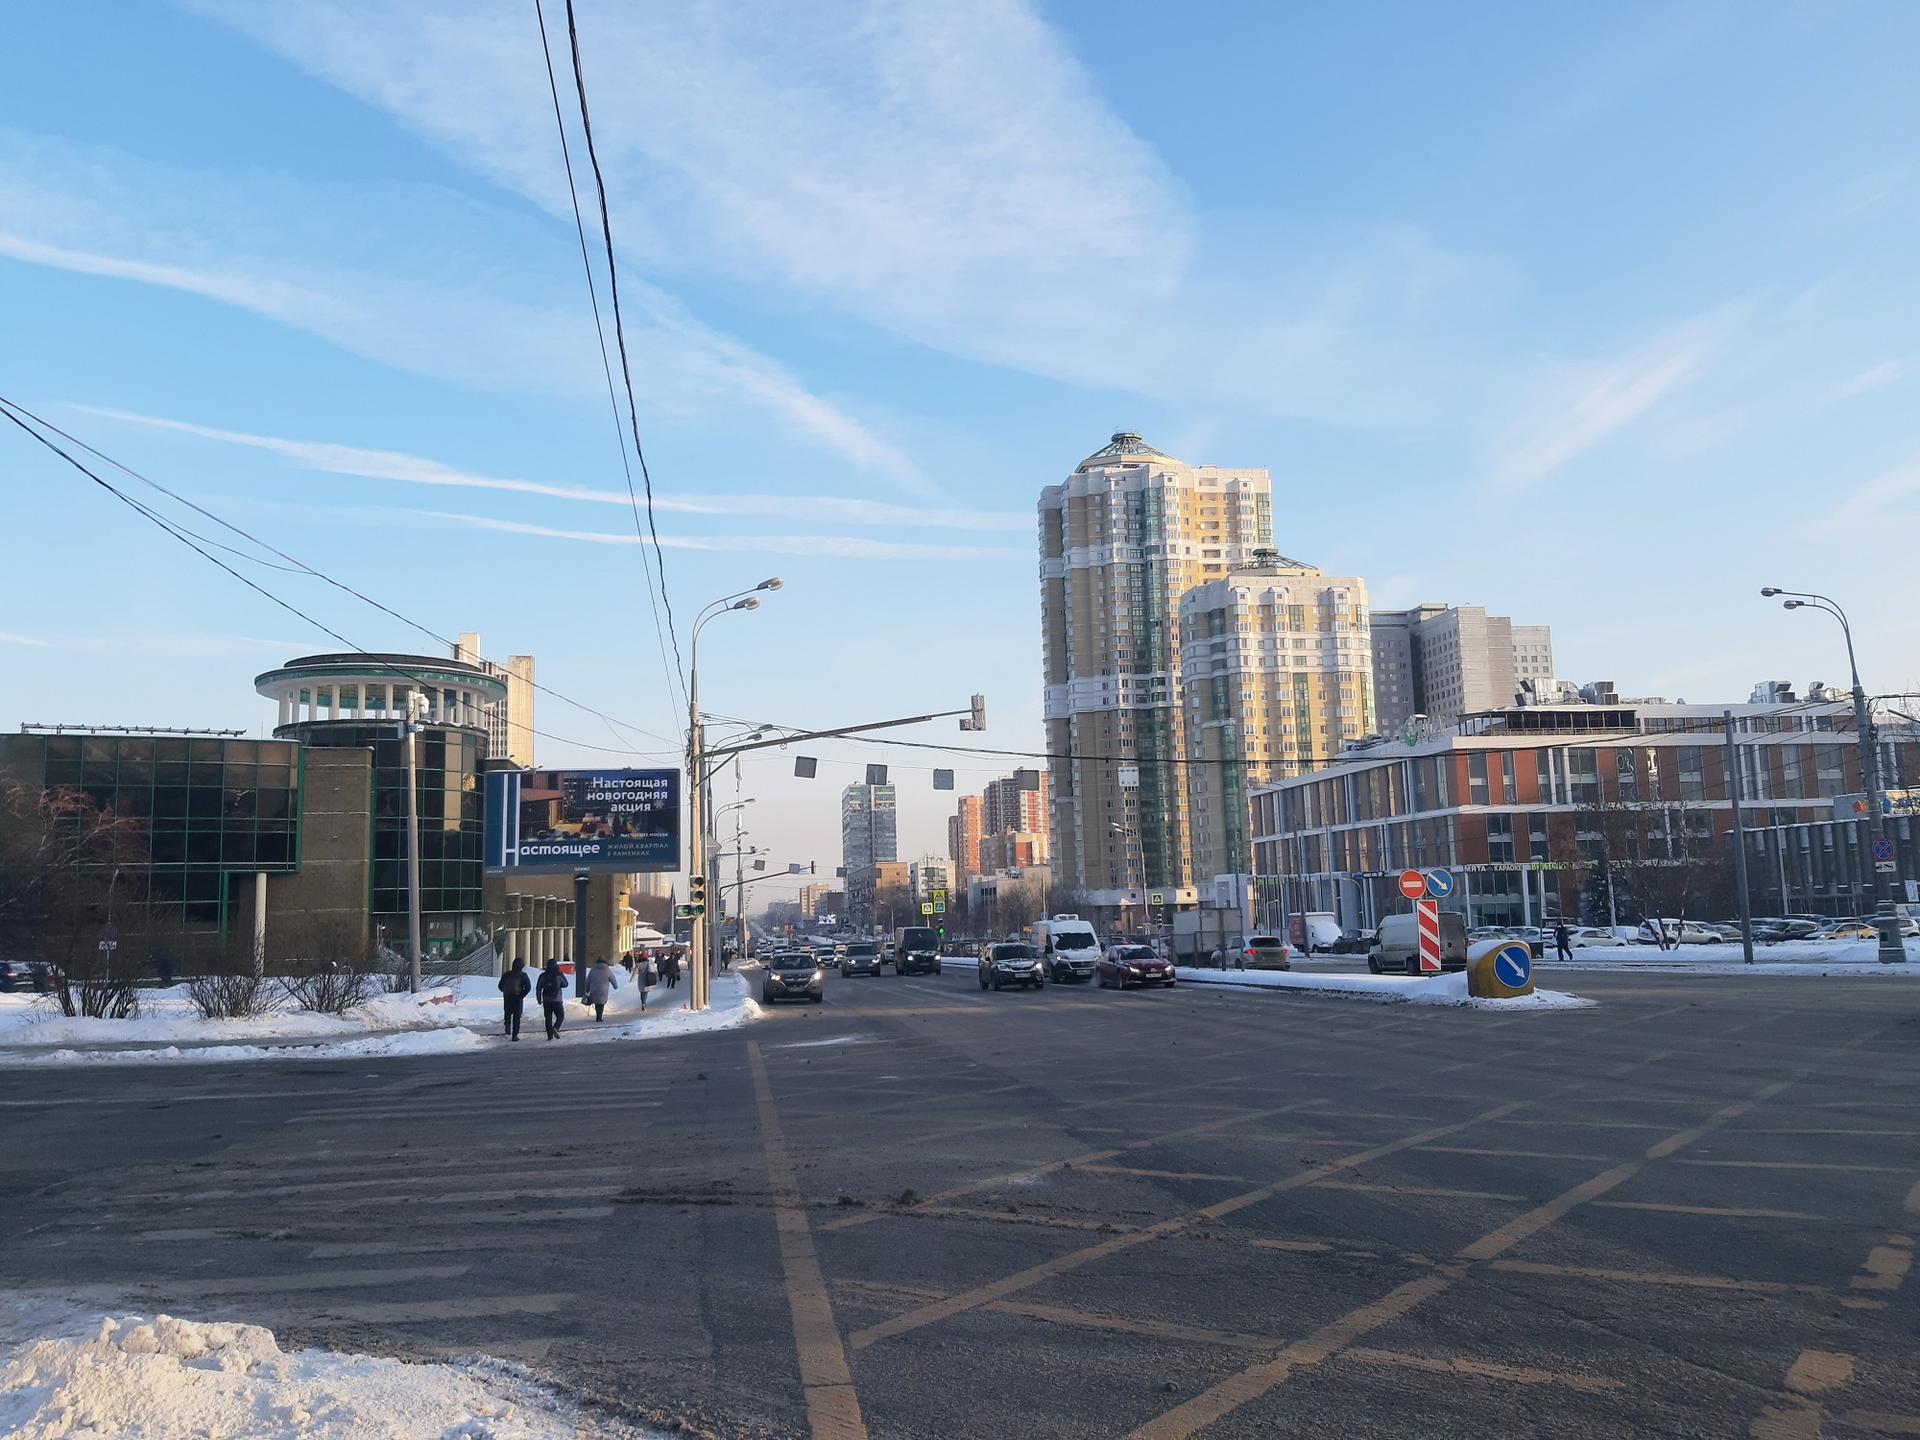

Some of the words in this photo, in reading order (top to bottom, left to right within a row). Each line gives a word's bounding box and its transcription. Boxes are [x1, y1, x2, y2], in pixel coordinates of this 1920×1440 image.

[592, 777, 668, 789] Настоящая
[587, 791, 668, 802] новогодняя
[611, 803, 651, 813] акция
[1464, 864, 1487, 872] МЯТА
